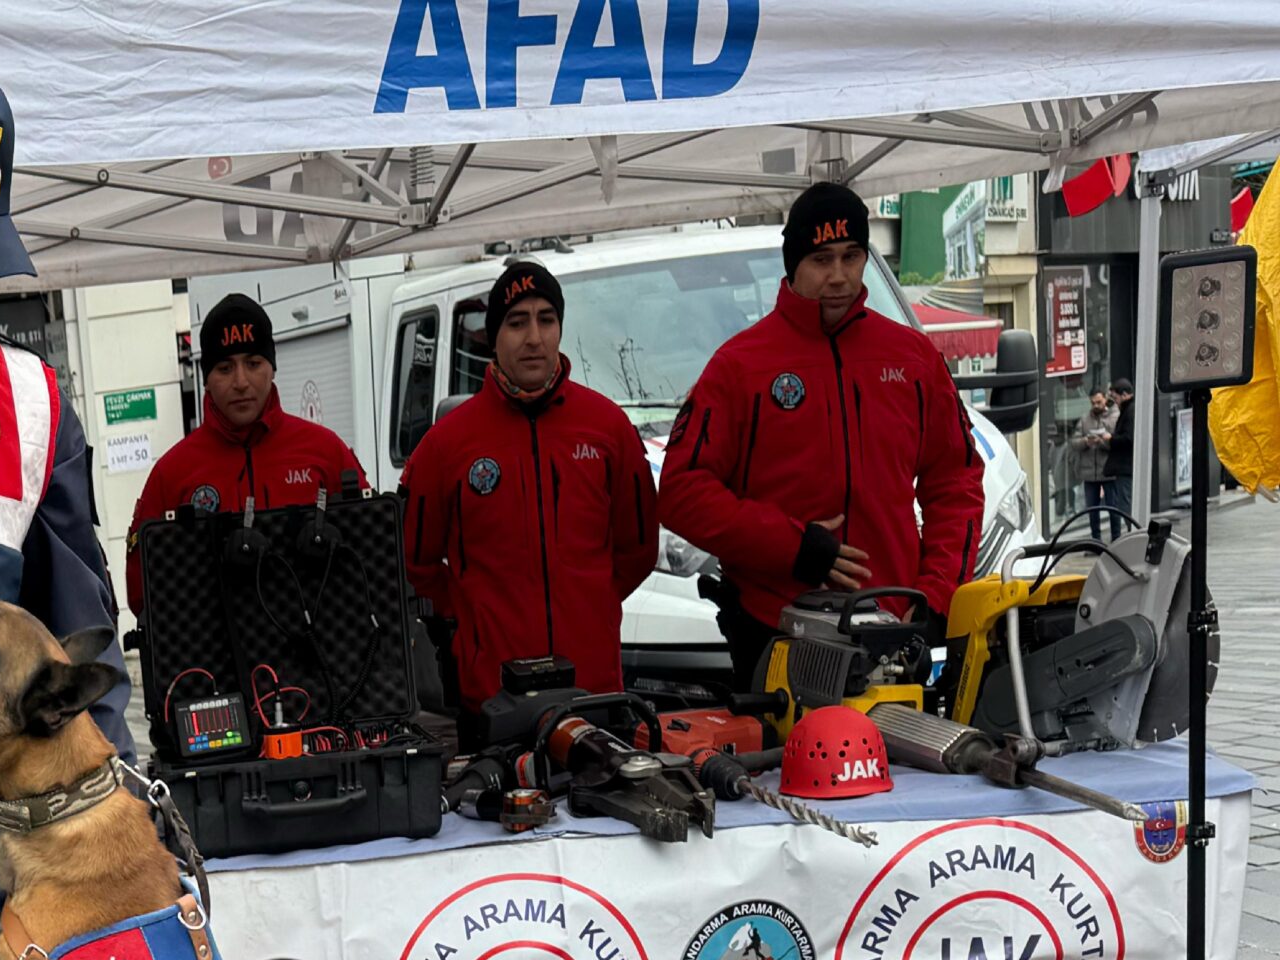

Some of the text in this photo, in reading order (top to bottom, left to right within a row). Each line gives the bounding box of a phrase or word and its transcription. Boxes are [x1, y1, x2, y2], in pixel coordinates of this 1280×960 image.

[373, 0, 760, 114] AFAD
[812, 218, 849, 246] JAK
[503, 274, 536, 305] JAK
[221, 323, 255, 347] JAK
[879, 366, 908, 384] JAK
[107, 433, 149, 447] KAMPANYA
[134, 448, 148, 462] 50
[571, 442, 600, 461] JAK
[284, 467, 313, 485] JAK
[276, 738, 283, 754] 1
[836, 757, 881, 783] JAK
[928, 844, 1036, 888] ARAMA
[463, 898, 567, 940] ARAMA
[732, 902, 774, 918] ARAMA
